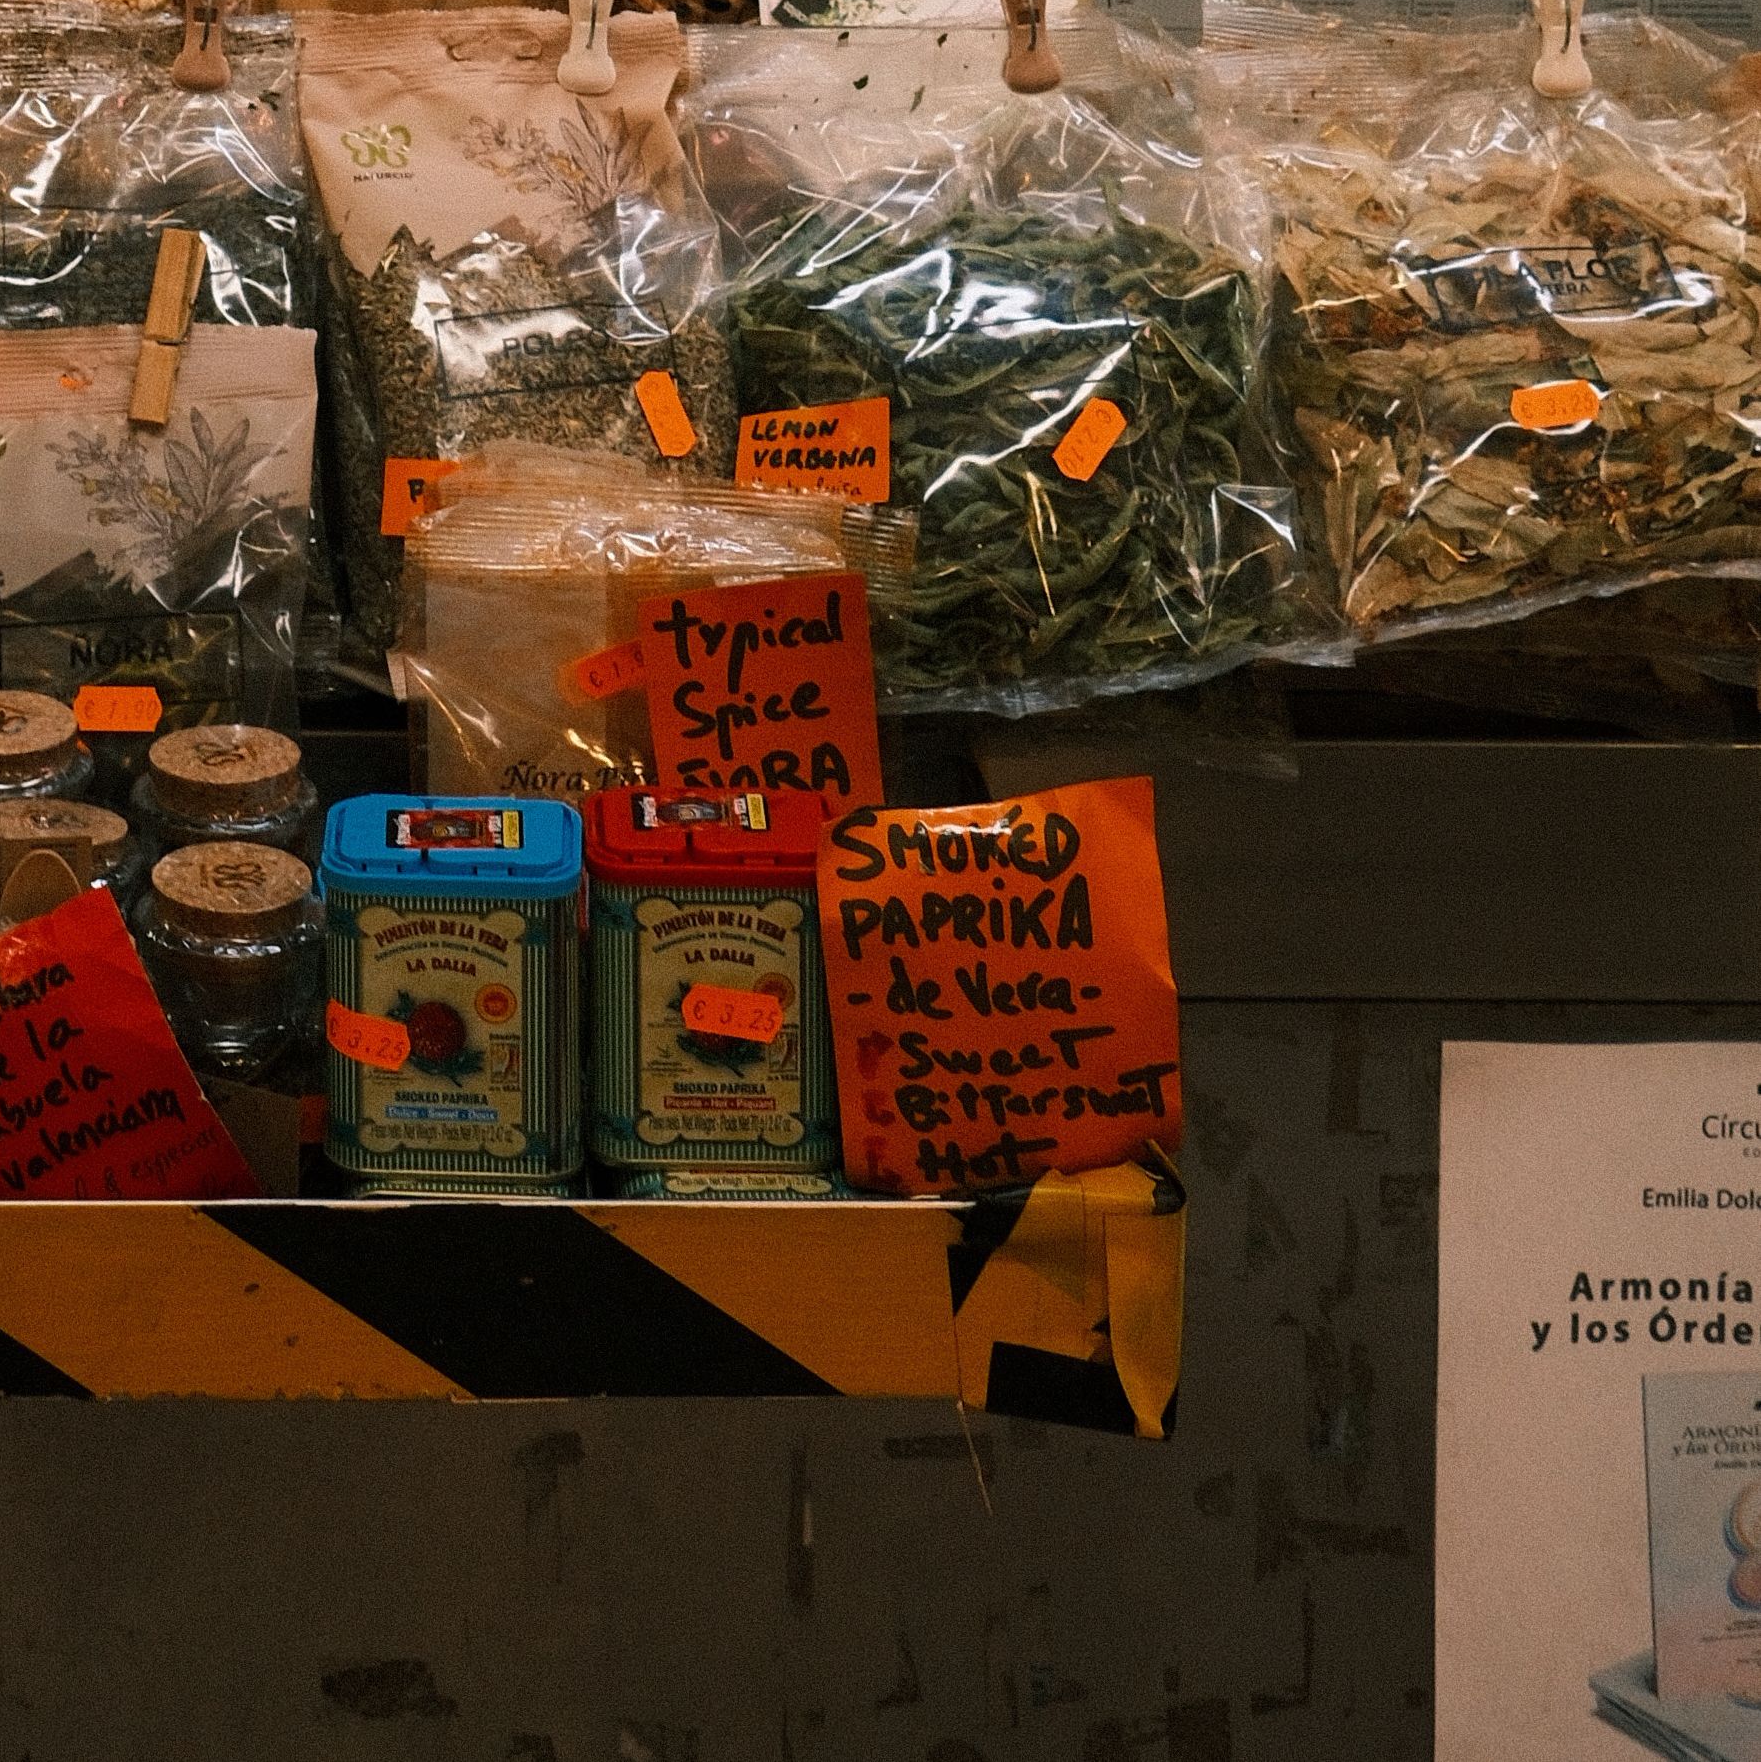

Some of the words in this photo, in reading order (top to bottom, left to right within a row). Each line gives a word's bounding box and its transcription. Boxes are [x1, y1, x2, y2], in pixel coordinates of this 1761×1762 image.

[751, 417, 839, 441] LEMON
[672, 680, 830, 761] Spice
[500, 759, 588, 793] Ñora
[831, 804, 1082, 882] SMOKED
[373, 919, 437, 949] PIMENTÓN
[478, 927, 509, 954] VERA
[652, 909, 715, 940] PIMENTÓN
[756, 917, 788, 943] VERA
[404, 959, 428, 975] LA
[431, 958, 478, 978] DALIA
[683, 950, 705, 965] LA
[709, 948, 756, 968] DALIA
[886, 955, 954, 1020] de
[1642, 1186, 1710, 1210] Emilia
[1568, 1270, 1755, 1303] Armonía
[1530, 1319, 1553, 1353] y
[1570, 1312, 1631, 1344] los
[1648, 1306, 1761, 1345] Órde
